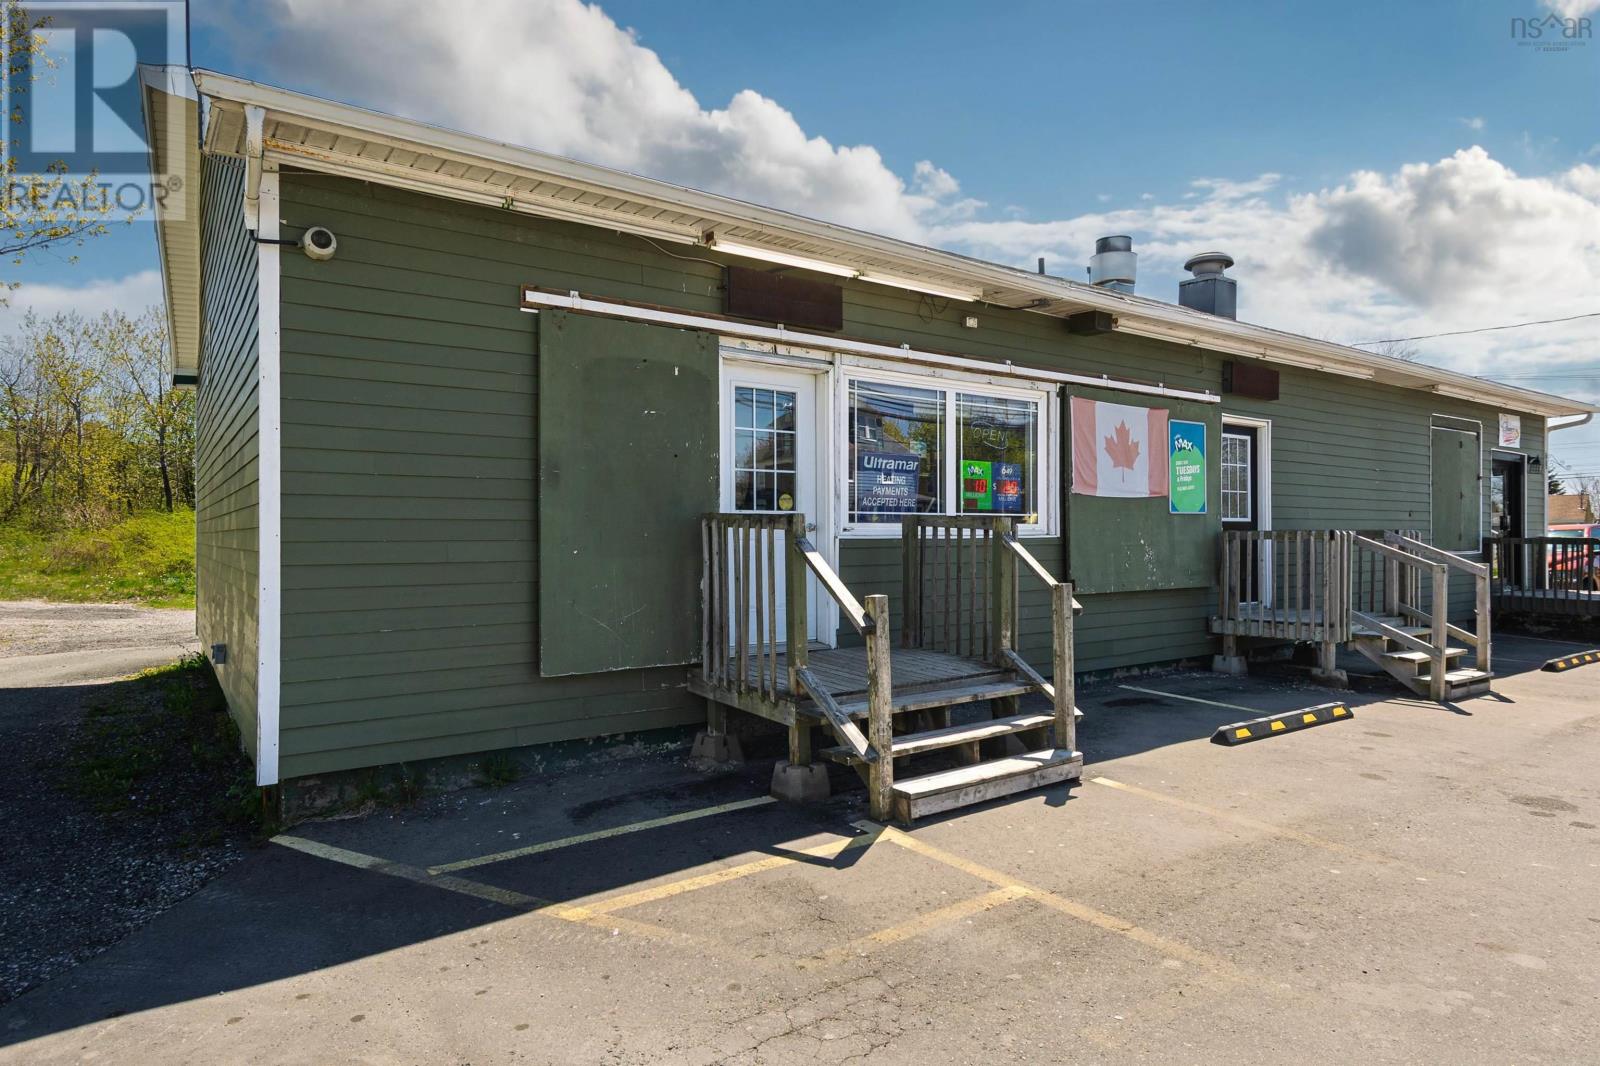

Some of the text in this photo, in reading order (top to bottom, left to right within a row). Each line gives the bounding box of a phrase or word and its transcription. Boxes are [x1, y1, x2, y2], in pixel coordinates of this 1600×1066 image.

[864, 455, 918, 470] Ultramar
[876, 475, 906, 485] HEATING
[873, 486, 909, 496] PAYMENTS
[862, 497, 916, 507] ACCEPTED HERE
